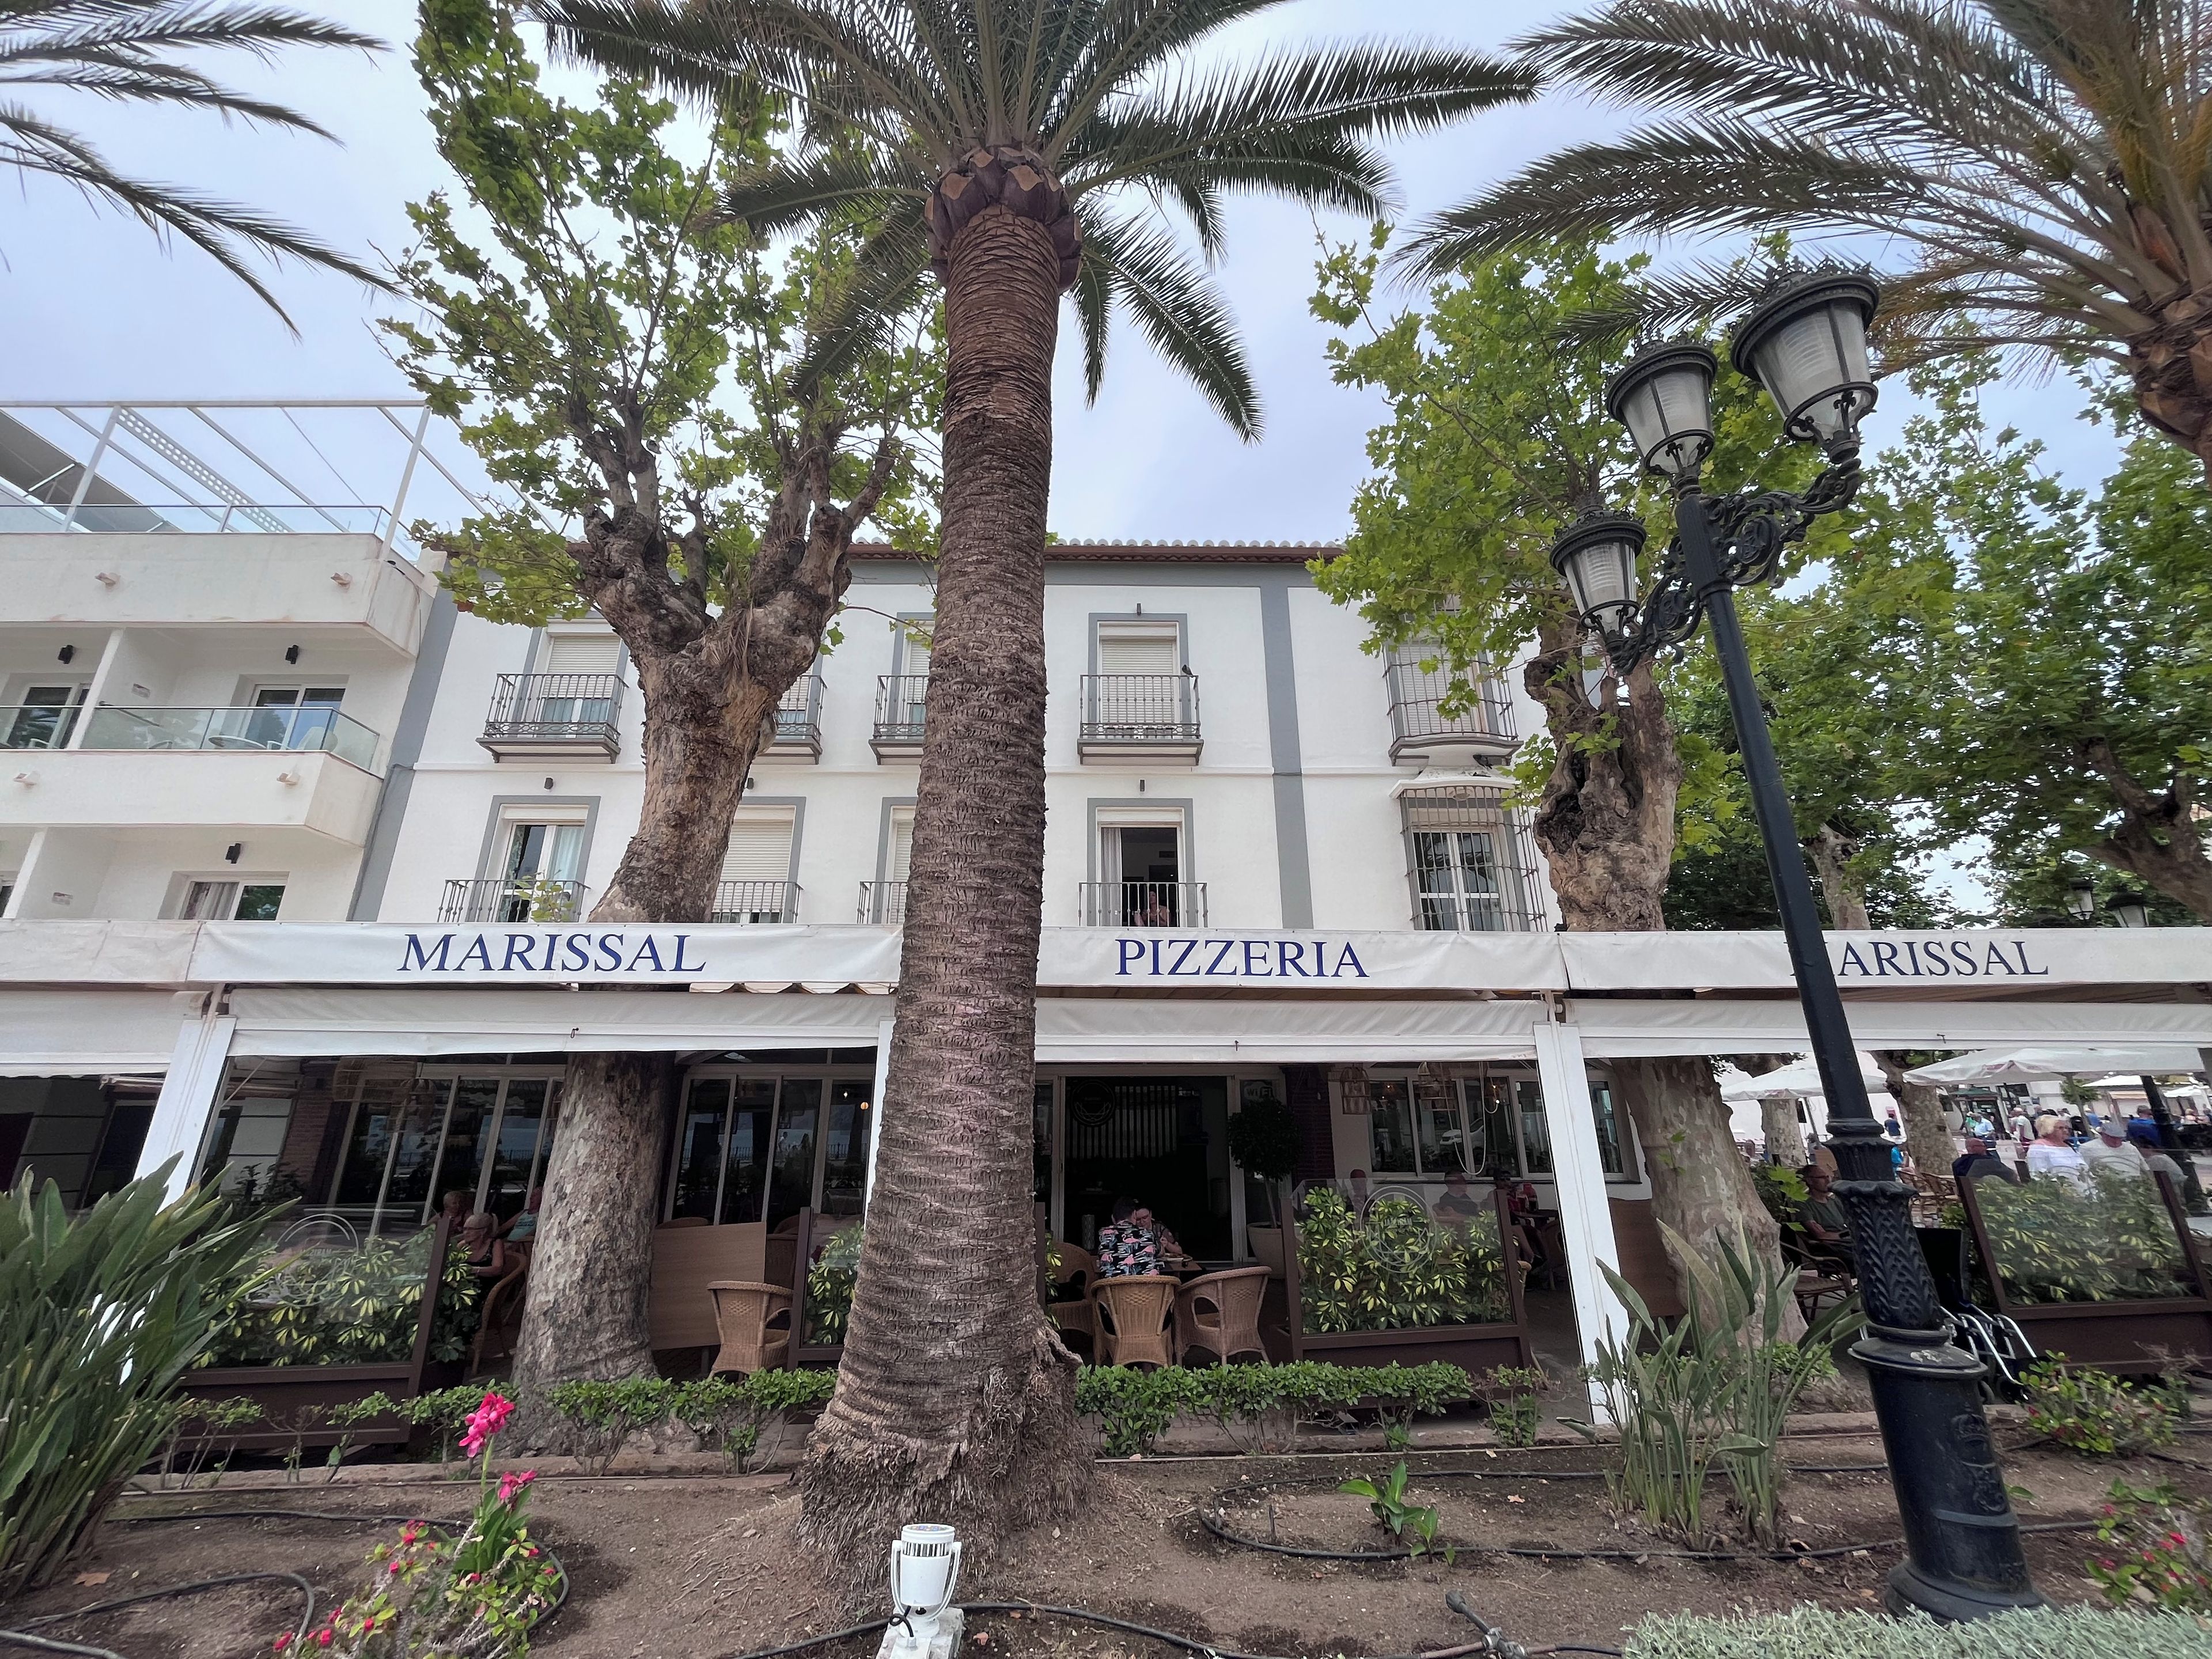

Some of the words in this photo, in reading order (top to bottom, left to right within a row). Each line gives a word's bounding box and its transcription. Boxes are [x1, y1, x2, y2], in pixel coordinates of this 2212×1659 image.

[397, 933, 706, 972] MARISSAL
[1114, 938, 1370, 978] PIZZERIA
[1784, 940, 2049, 976] ARISSAL
